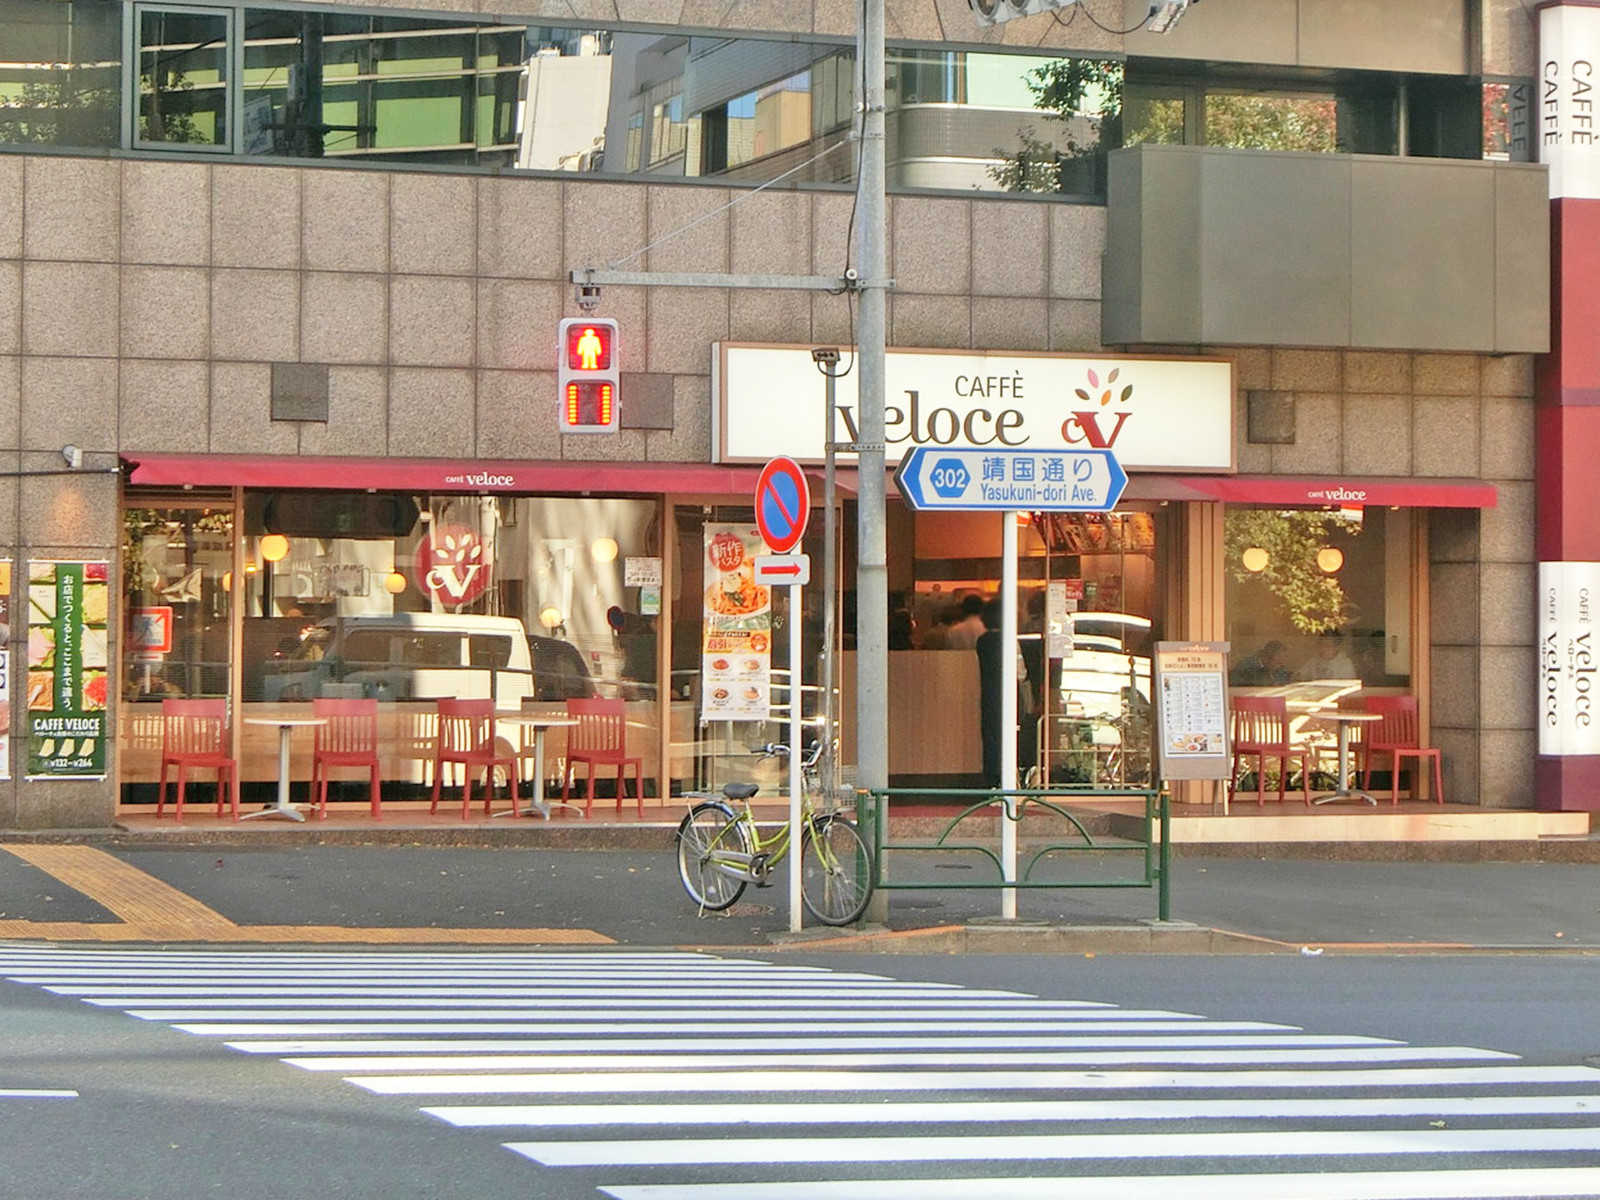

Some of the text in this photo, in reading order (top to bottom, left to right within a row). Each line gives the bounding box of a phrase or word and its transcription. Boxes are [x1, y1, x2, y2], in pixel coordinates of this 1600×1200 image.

[1543, 60, 1563, 147] CAFFÈ
[1571, 59, 1599, 146] CAFFÈ
[955, 369, 1025, 399] CAFFÈ
[466, 471, 516, 486] veloce
[934, 467, 967, 489] 302
[982, 456, 1093, 483] 靖国通り
[980, 482, 1098, 502] Yasukuni-dori Ave.
[1325, 486, 1367, 500] veloce
[65, 718, 100, 731] VELOCE
